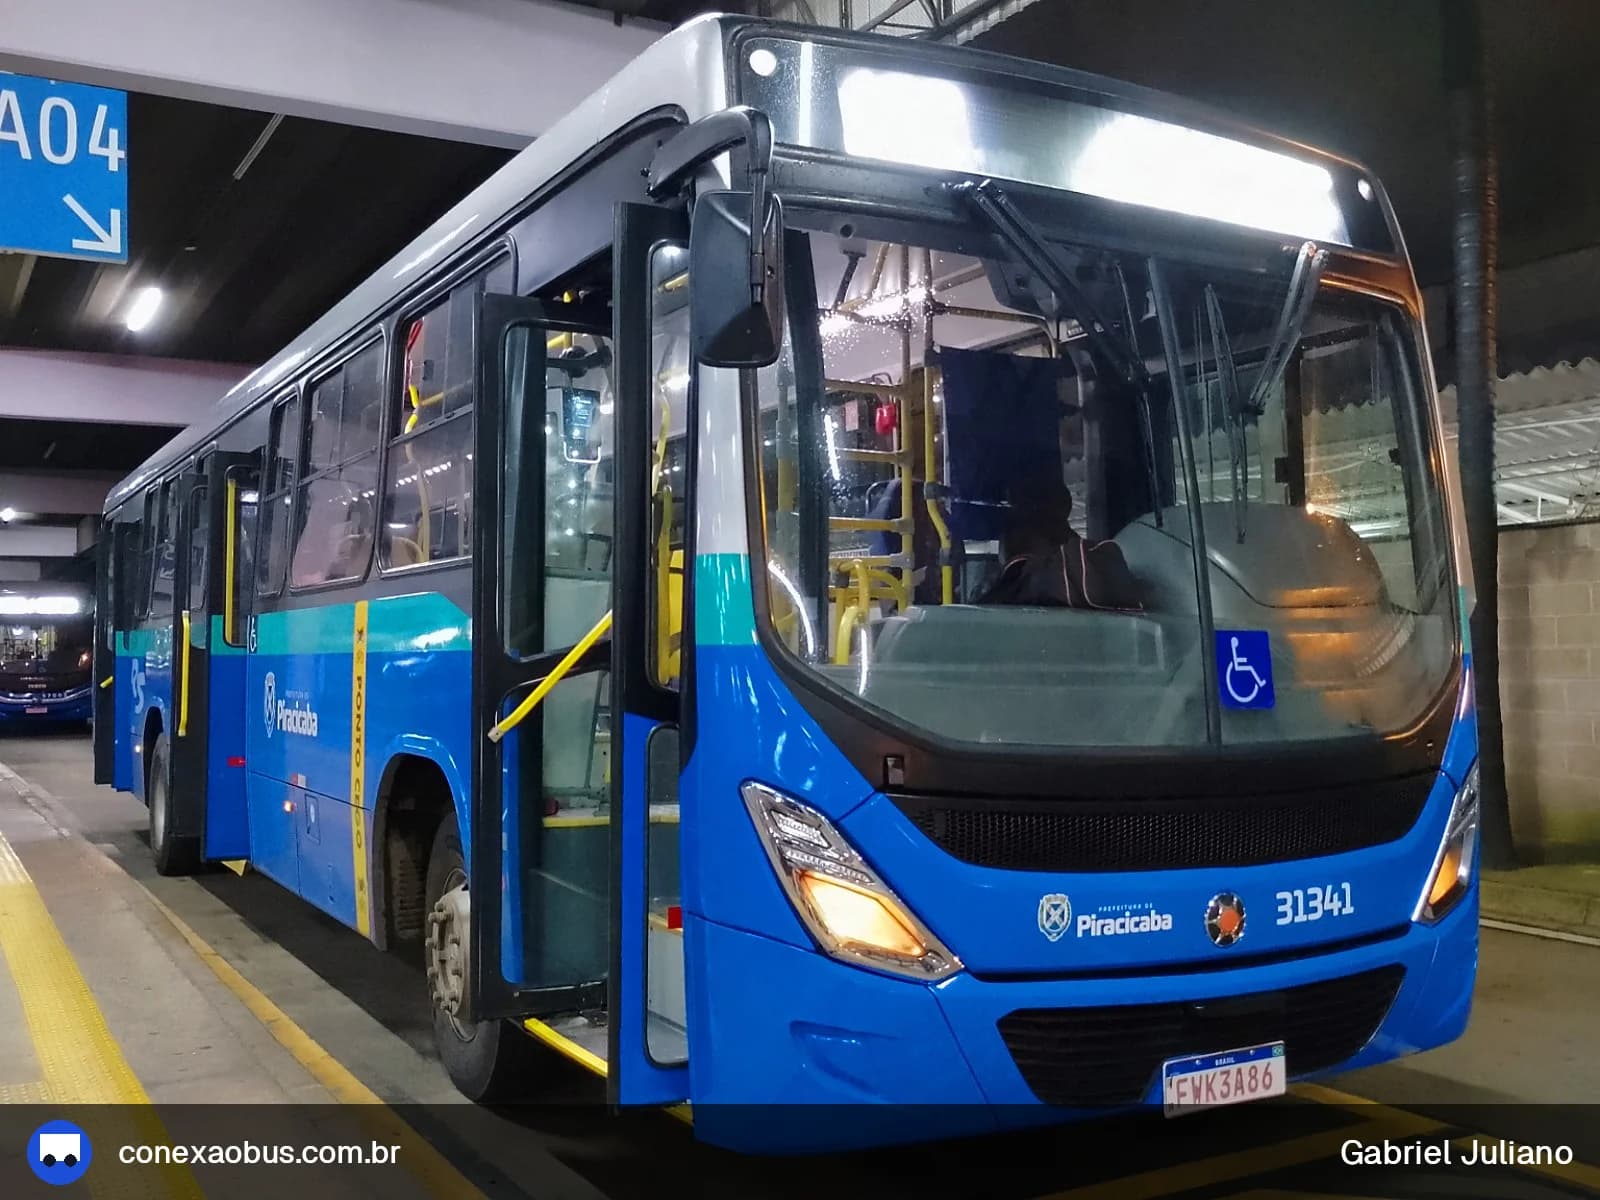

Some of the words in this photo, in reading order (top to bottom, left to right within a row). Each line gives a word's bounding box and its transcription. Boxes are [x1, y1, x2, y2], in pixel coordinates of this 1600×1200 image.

[0, 89, 125, 172] A04
[277, 699, 318, 737] Piracicaba
[353, 675, 363, 767] PONTO
[1076, 909, 1173, 938] Piracicaba
[1276, 882, 1355, 926] 31341
[1176, 1062, 1273, 1108] FWK3A86
